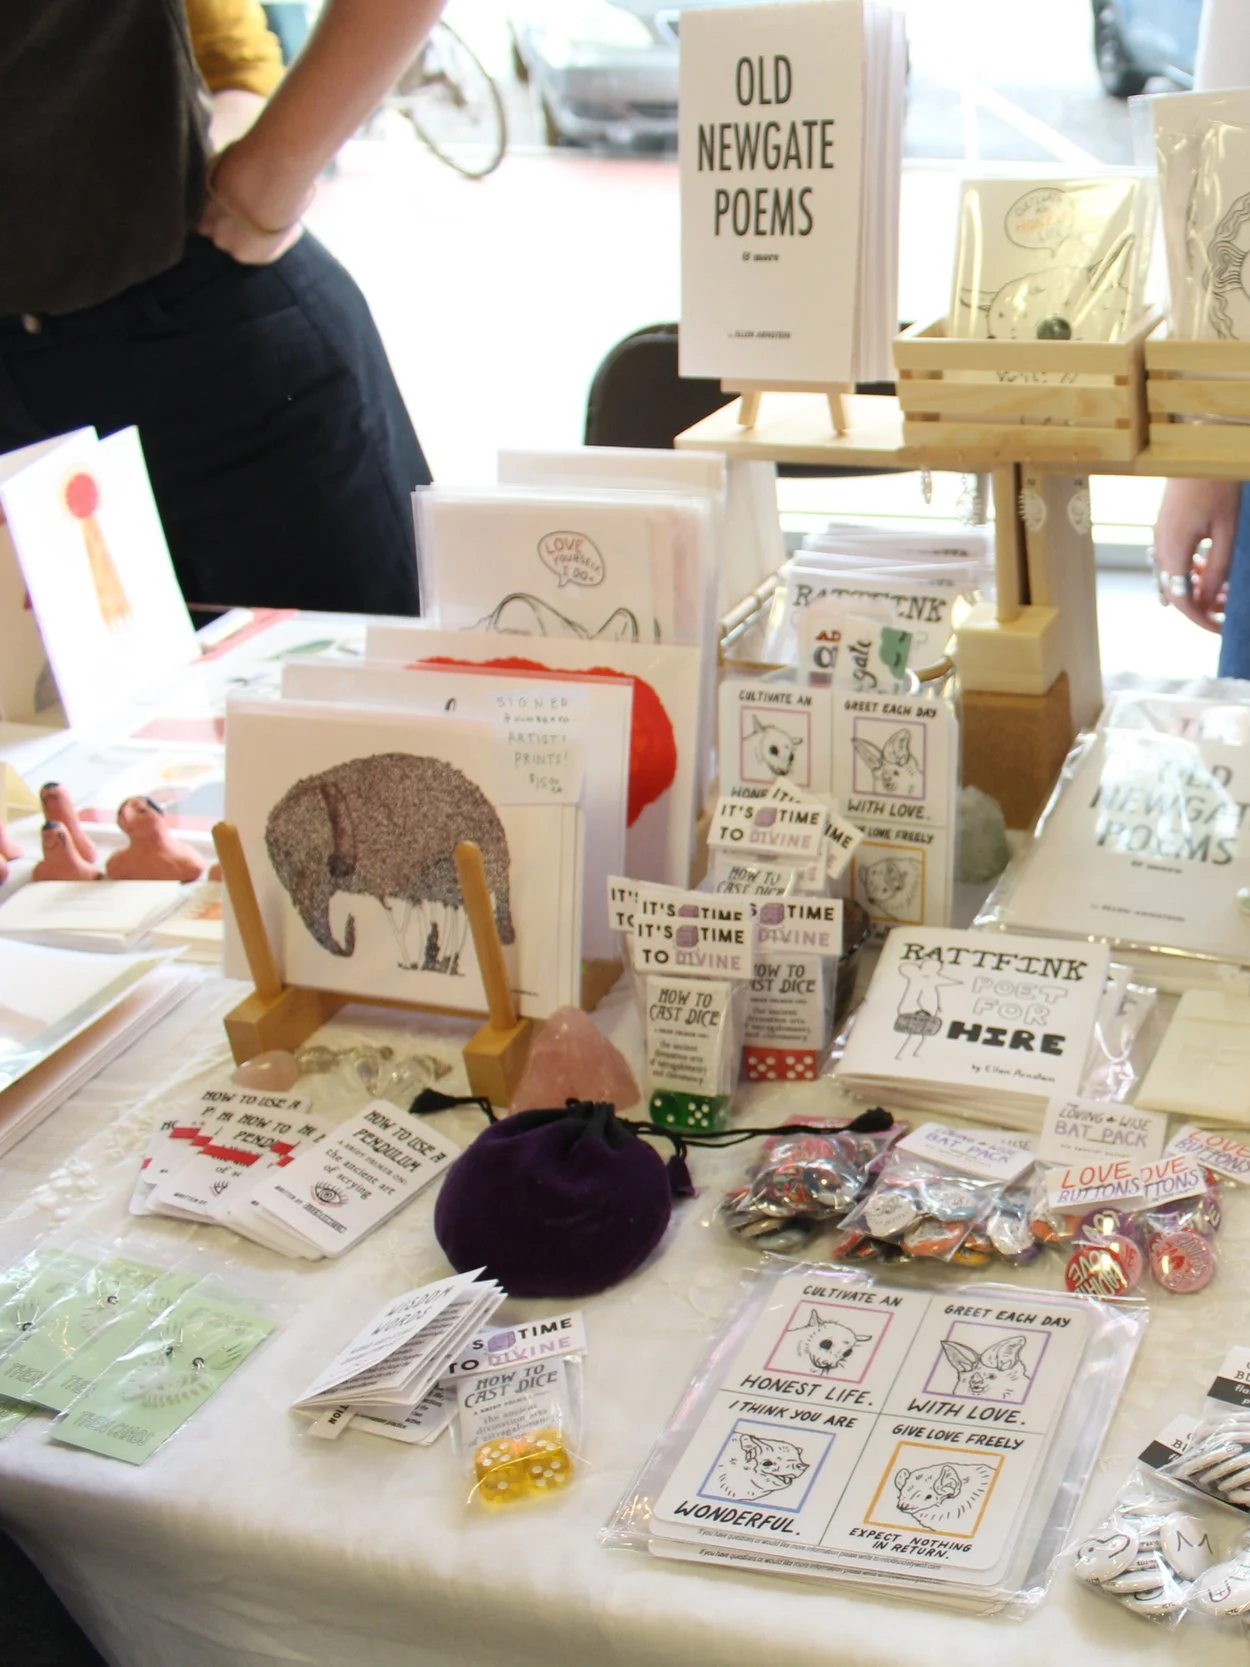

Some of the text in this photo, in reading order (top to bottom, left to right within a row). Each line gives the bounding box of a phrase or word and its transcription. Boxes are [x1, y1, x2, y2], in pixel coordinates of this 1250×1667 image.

[736, 54, 792, 106] OLD
[697, 118, 835, 172] NEWGATE
[714, 186, 813, 237] POEMS
[720, 803, 820, 826] IT'S TIME
[719, 826, 812, 850] TO DIVINE
[637, 924, 745, 945] IT'S TIME
[641, 949, 742, 971] TO DIVINE
[899, 942, 1089, 982] RATTFINK
[657, 987, 713, 1009] HOW TO
[971, 975, 1070, 1005] POET
[649, 1004, 721, 1028] CAST DICE
[972, 997, 1051, 1028] FOR
[946, 1019, 1067, 1057] HIRE
[363, 1109, 448, 1165] HOW TO USE A
[1054, 1119, 1149, 1150] BAT PACK
[351, 1127, 422, 1174] PENDULUM
[325, 1148, 396, 1196] the ancient art
[1060, 1158, 1134, 1190] LOVE
[1057, 1177, 1140, 1204] BUTTONS
[802, 1284, 903, 1308] CULTIVATE AN
[517, 1318, 573, 1340] TIME
[943, 1304, 1072, 1329] GREET EACH DAY
[487, 1336, 572, 1367] DIVINE
[740, 1374, 874, 1407] HONEST LIFE.
[728, 1400, 859, 1429] I THINK YOU ARE
[907, 1398, 1027, 1426] WITH LOVE.
[891, 1423, 1025, 1451] GIVE LOVE FREELY
[673, 1500, 801, 1536] WONDERFUL.
[848, 1527, 974, 1553] EXPECT NOTHING
[871, 1540, 950, 1560] IN RETURN.
